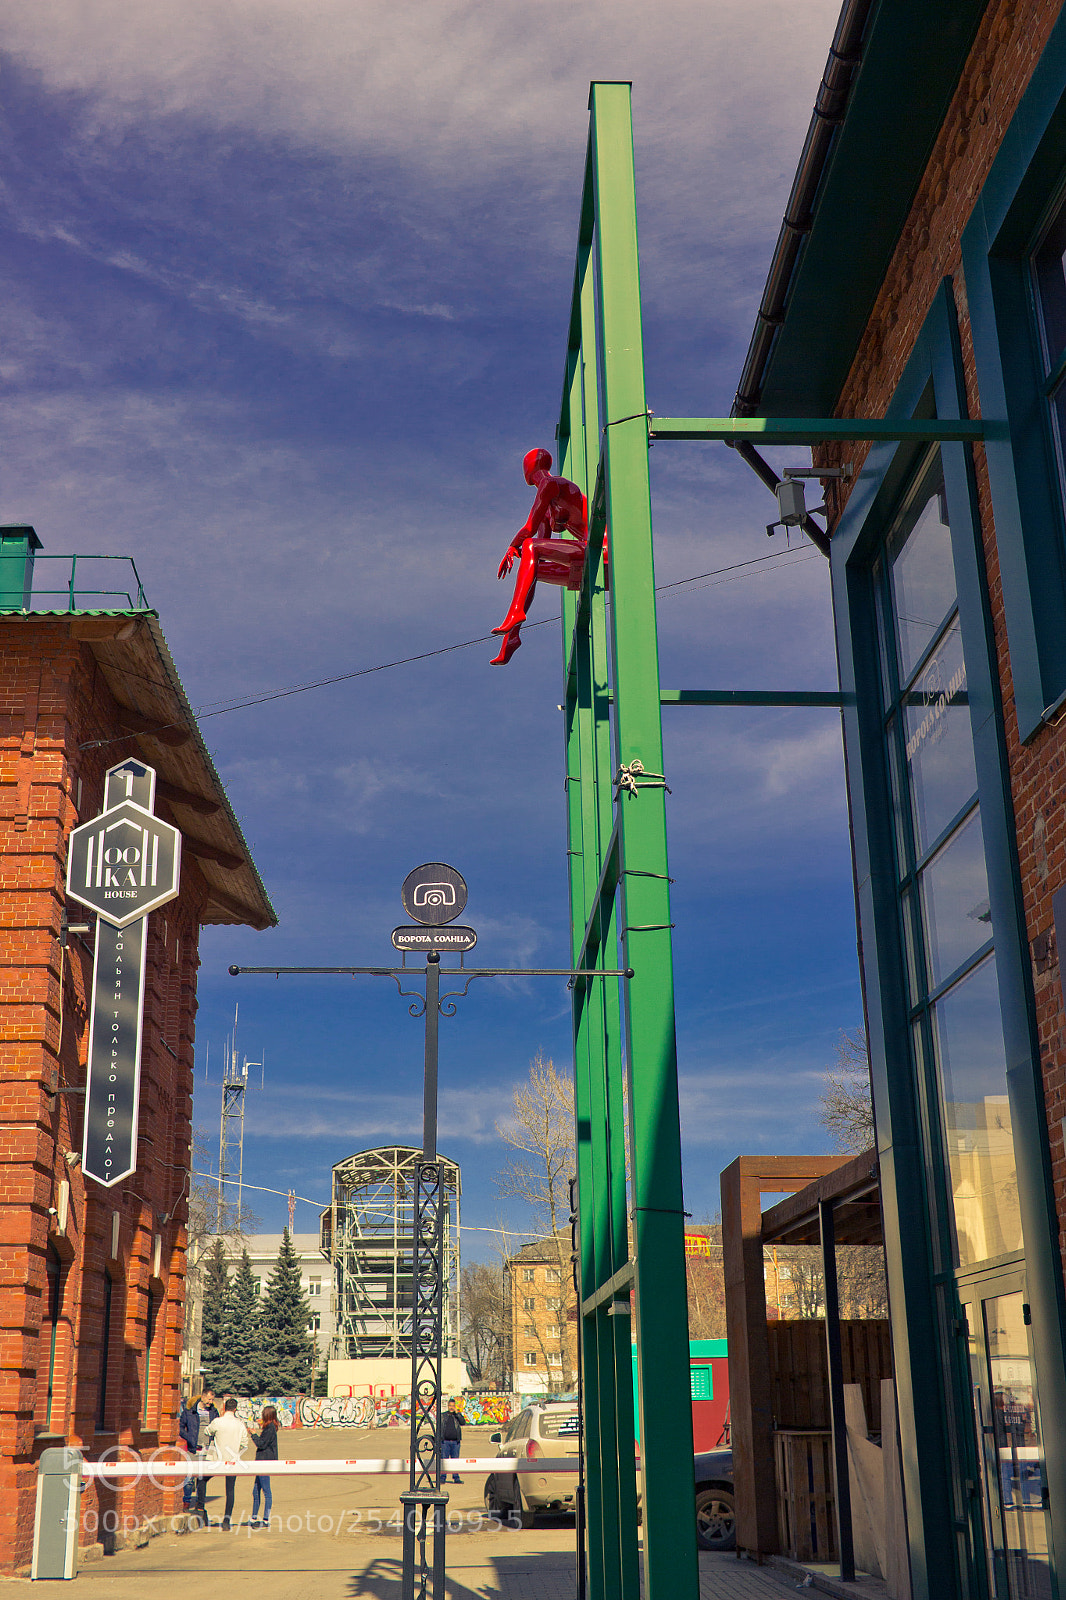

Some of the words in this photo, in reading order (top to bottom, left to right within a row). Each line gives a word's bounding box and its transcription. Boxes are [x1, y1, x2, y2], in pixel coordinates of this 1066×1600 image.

[104, 890, 138, 899] HOUSE
[114, 931, 124, 1000] кальян
[398, 935, 432, 943] ВОРОТА
[434, 935, 470, 943] СОЛНЦА
[108, 1011, 120, 1082] только
[104, 1093, 116, 1180] предлог
